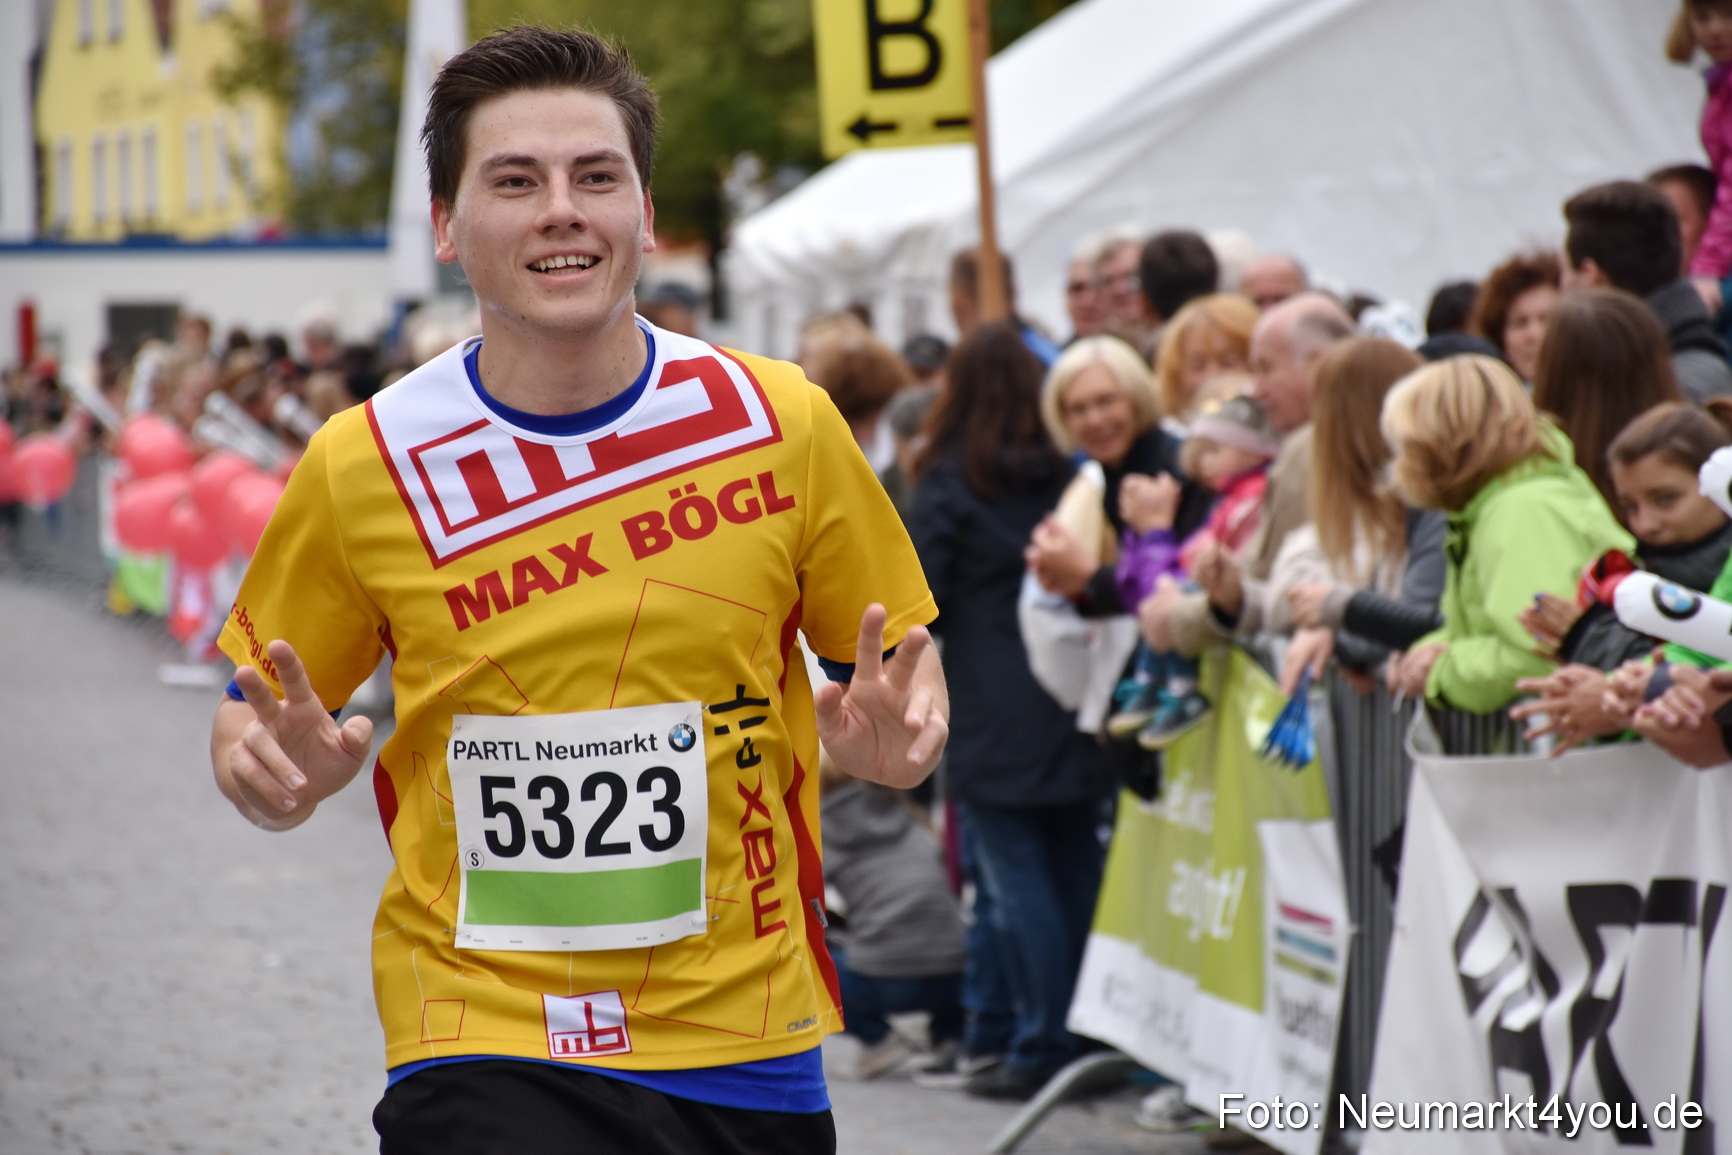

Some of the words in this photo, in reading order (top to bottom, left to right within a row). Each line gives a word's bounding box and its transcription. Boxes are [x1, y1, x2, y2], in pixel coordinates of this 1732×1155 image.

[863, 0, 943, 91] B
[443, 532, 610, 632] MAX
[620, 470, 796, 561] BÖGL
[453, 740, 530, 761] PARTL
[535, 733, 658, 761] Neumarkt
[479, 766, 686, 860] 5323
[470, 852, 480, 867] S
